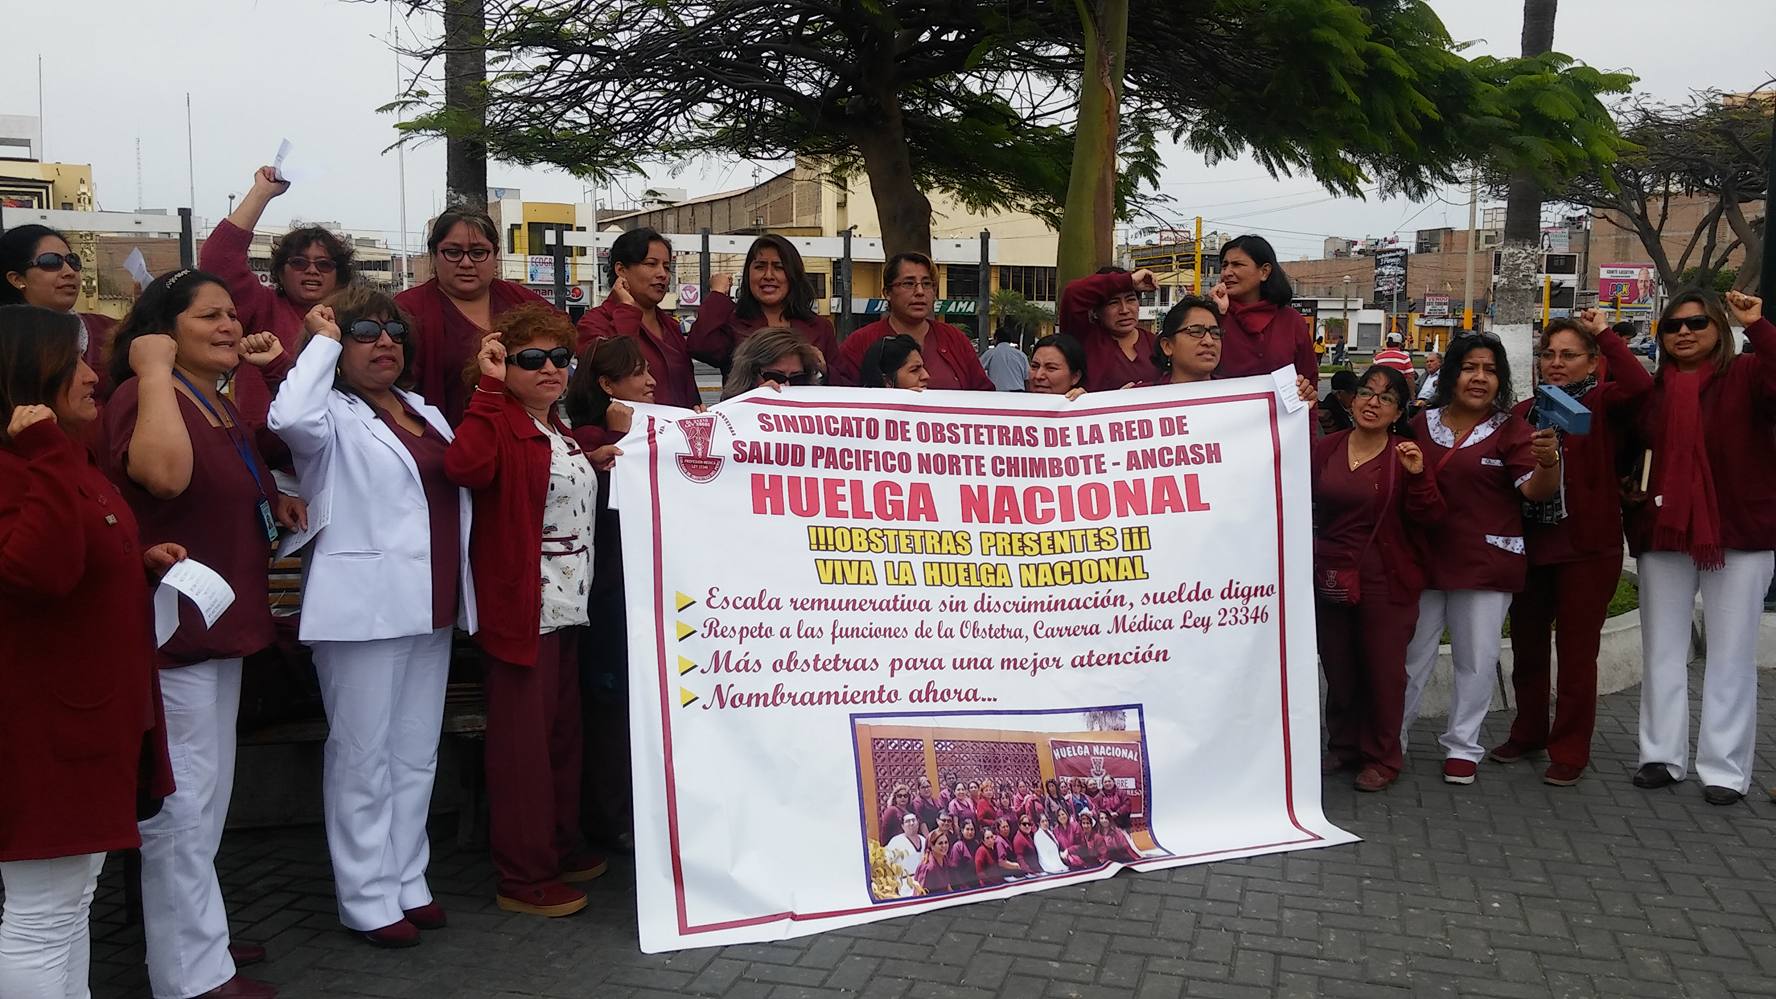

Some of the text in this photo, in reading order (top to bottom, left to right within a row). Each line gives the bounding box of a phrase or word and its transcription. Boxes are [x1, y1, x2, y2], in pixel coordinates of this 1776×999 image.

[1608, 281, 1630, 297] PPK
[947, 301, 976, 313] AMA
[757, 413, 1190, 448] SINDICATO DE OBSTETRAS DE LA RED DE
[732, 440, 806, 467] SALUD
[811, 445, 912, 474] PACIFICO
[917, 452, 986, 476] NORTE
[991, 453, 1107, 478] CHIMBOTE
[1126, 442, 1222, 472] ANCASH
[750, 473, 1211, 524] HUELGA NACIONAL
[807, 525, 972, 556] !!!OBSTETRAS
[979, 526, 1118, 557] PRESENTES
[814, 555, 1149, 588] VIVA LA HUELGA NACIONAL
[705, 579, 1277, 613] Escala remunerativa sin discriminación, sueldo digno
[700, 604, 1269, 645] Respeto a las funciones de la Obstetra, Carrera Médica Ley 23346
[700, 644, 1171, 678] Más obstetras para una mejor atención
[702, 680, 998, 710] Nombramiento ahora...
[1053, 745, 1139, 762] HUELGA NACIONAL
